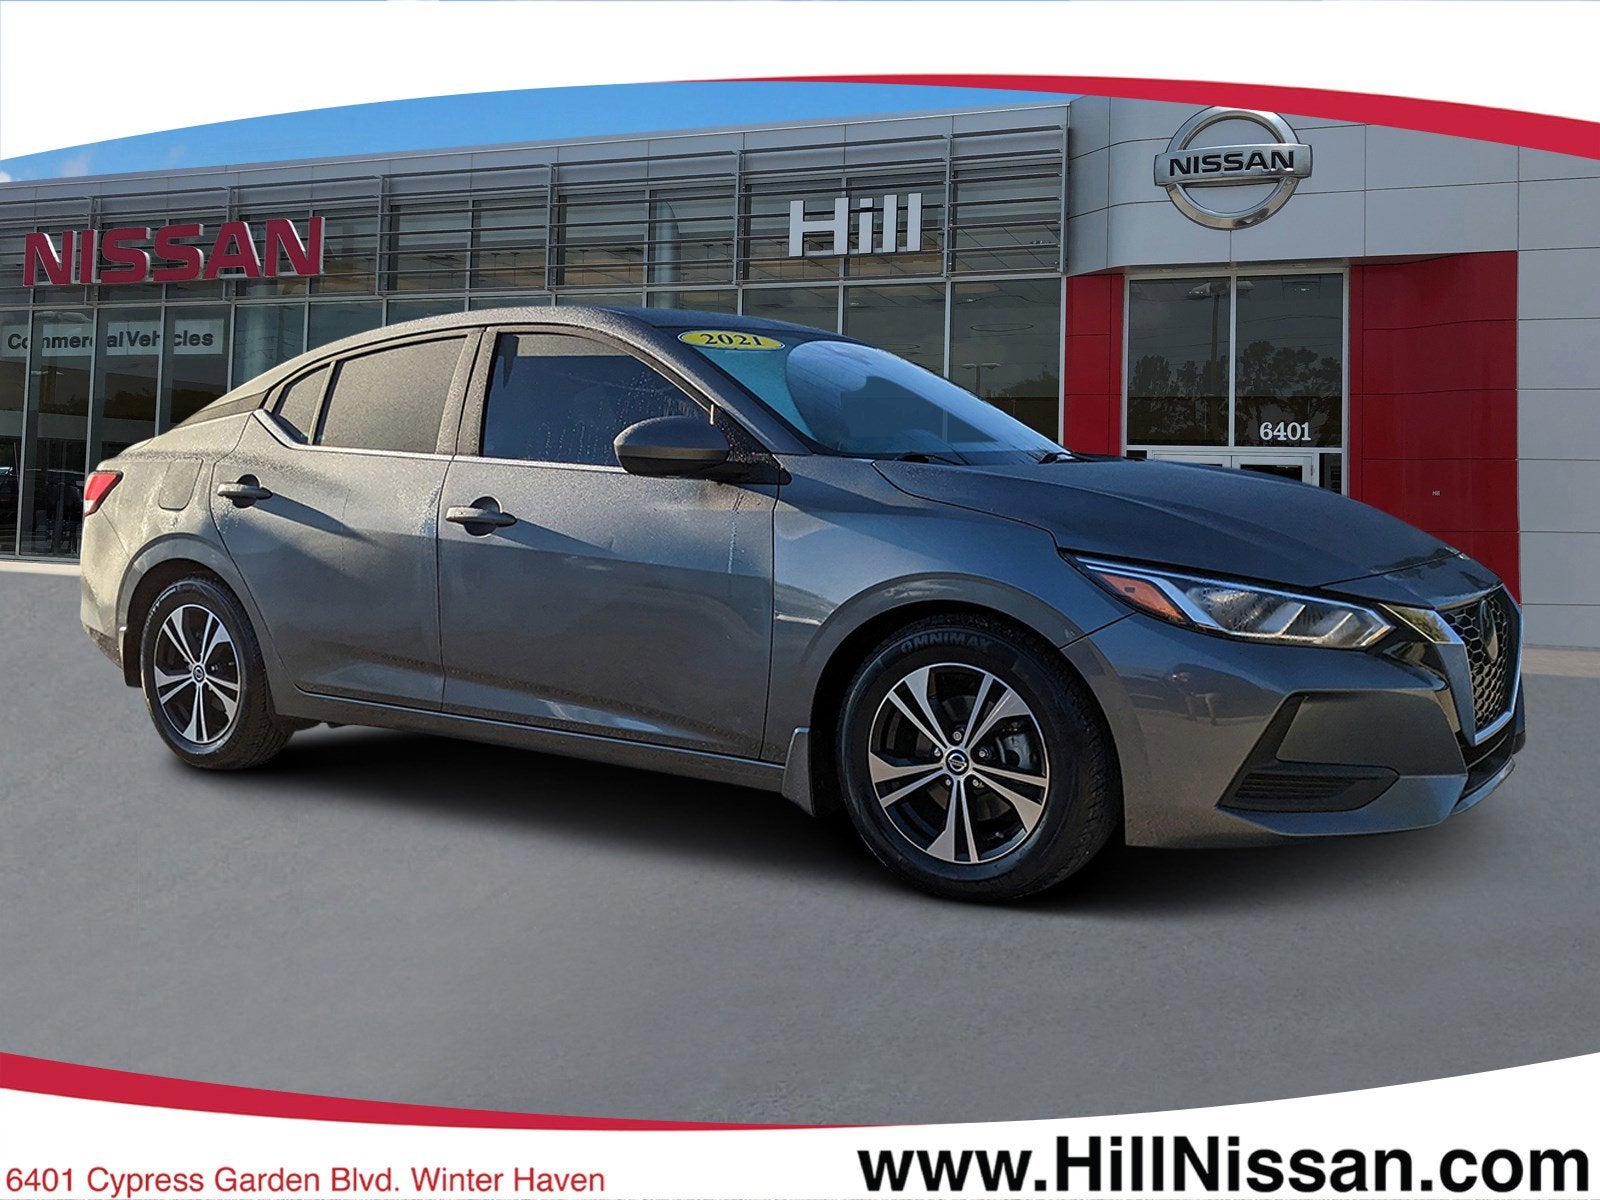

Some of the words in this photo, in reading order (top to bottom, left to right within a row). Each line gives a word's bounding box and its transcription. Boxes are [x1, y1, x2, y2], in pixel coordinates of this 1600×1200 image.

[1169, 151, 1295, 176] NISSAN
[788, 193, 923, 257] Hill
[23, 216, 325, 287] NISSAN
[126, 330, 214, 347] Vehcles
[700, 333, 763, 346] 2021
[1259, 421, 1311, 441] 6401
